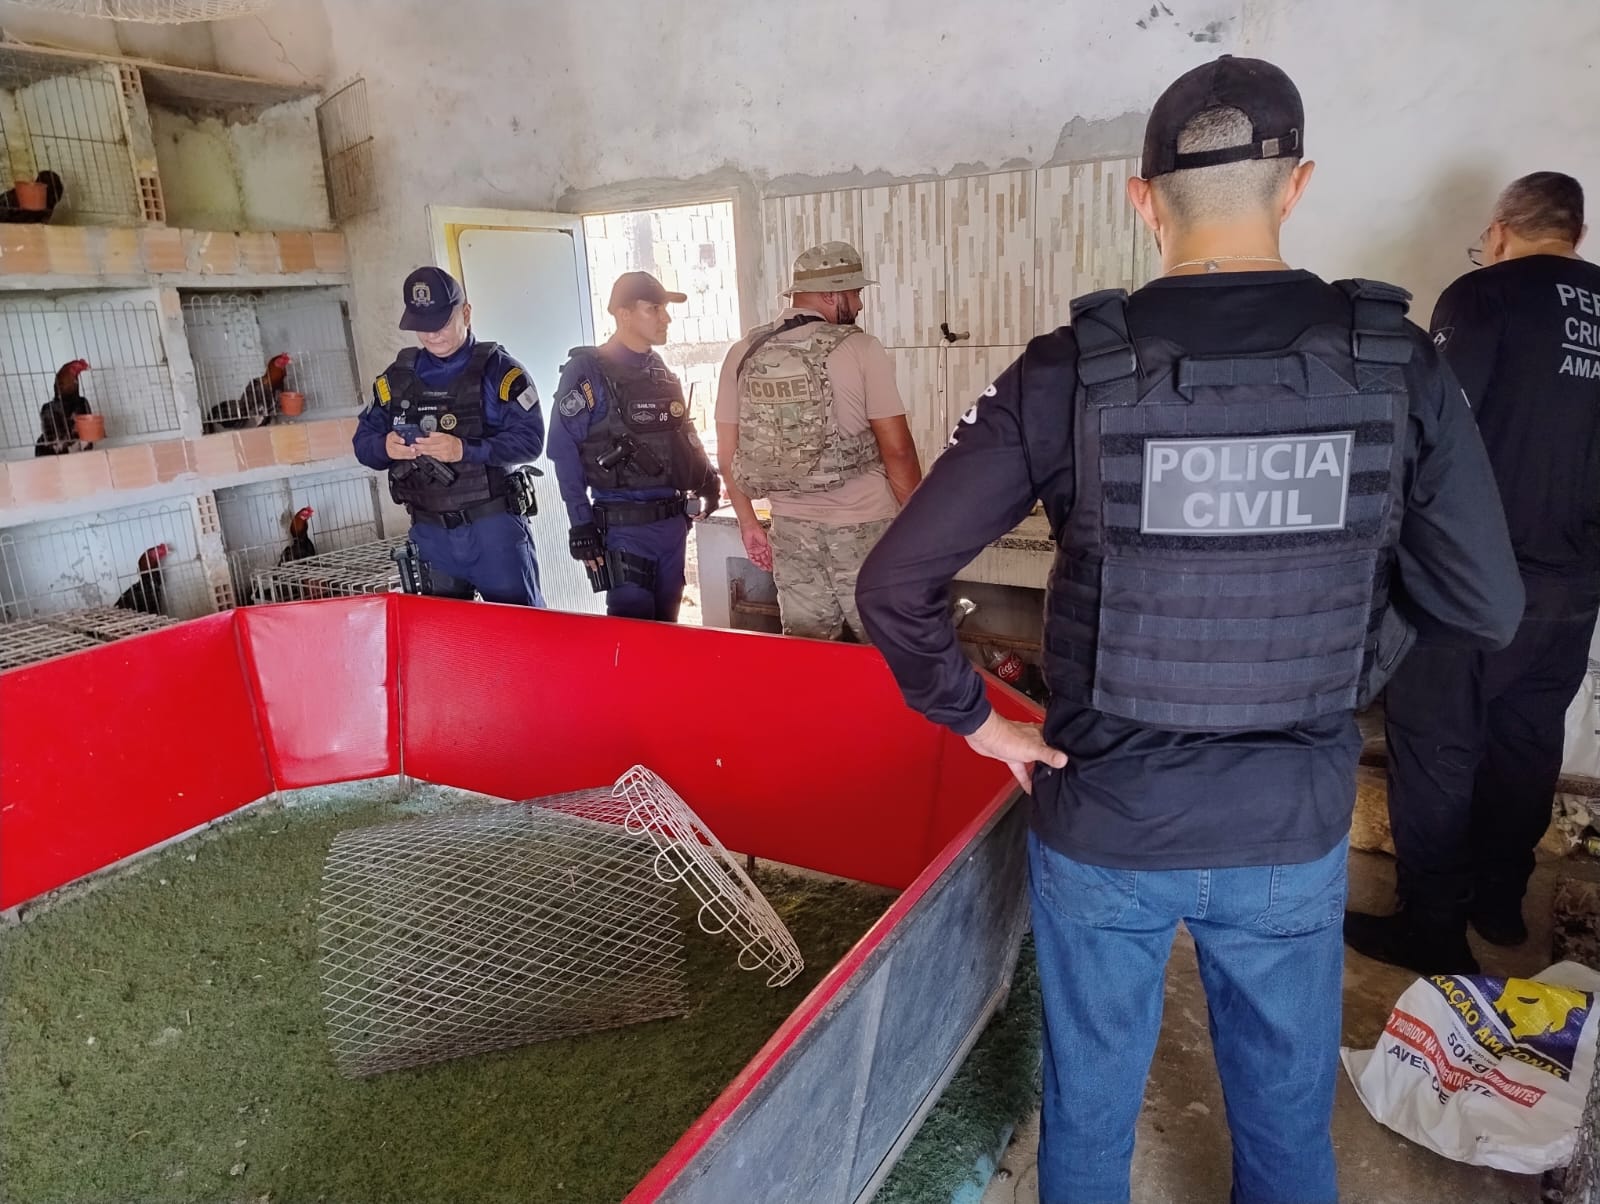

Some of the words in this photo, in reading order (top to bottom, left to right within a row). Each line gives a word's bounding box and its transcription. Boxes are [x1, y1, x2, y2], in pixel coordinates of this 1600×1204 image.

[1565, 317, 1600, 347] CRI
[1559, 355, 1600, 379] AMA
[750, 378, 808, 398] CORE
[1183, 489, 1313, 528] CIVIL
[1430, 975, 1480, 1025] RAÇÃO
[1474, 1027, 1562, 1078] AMONAS
